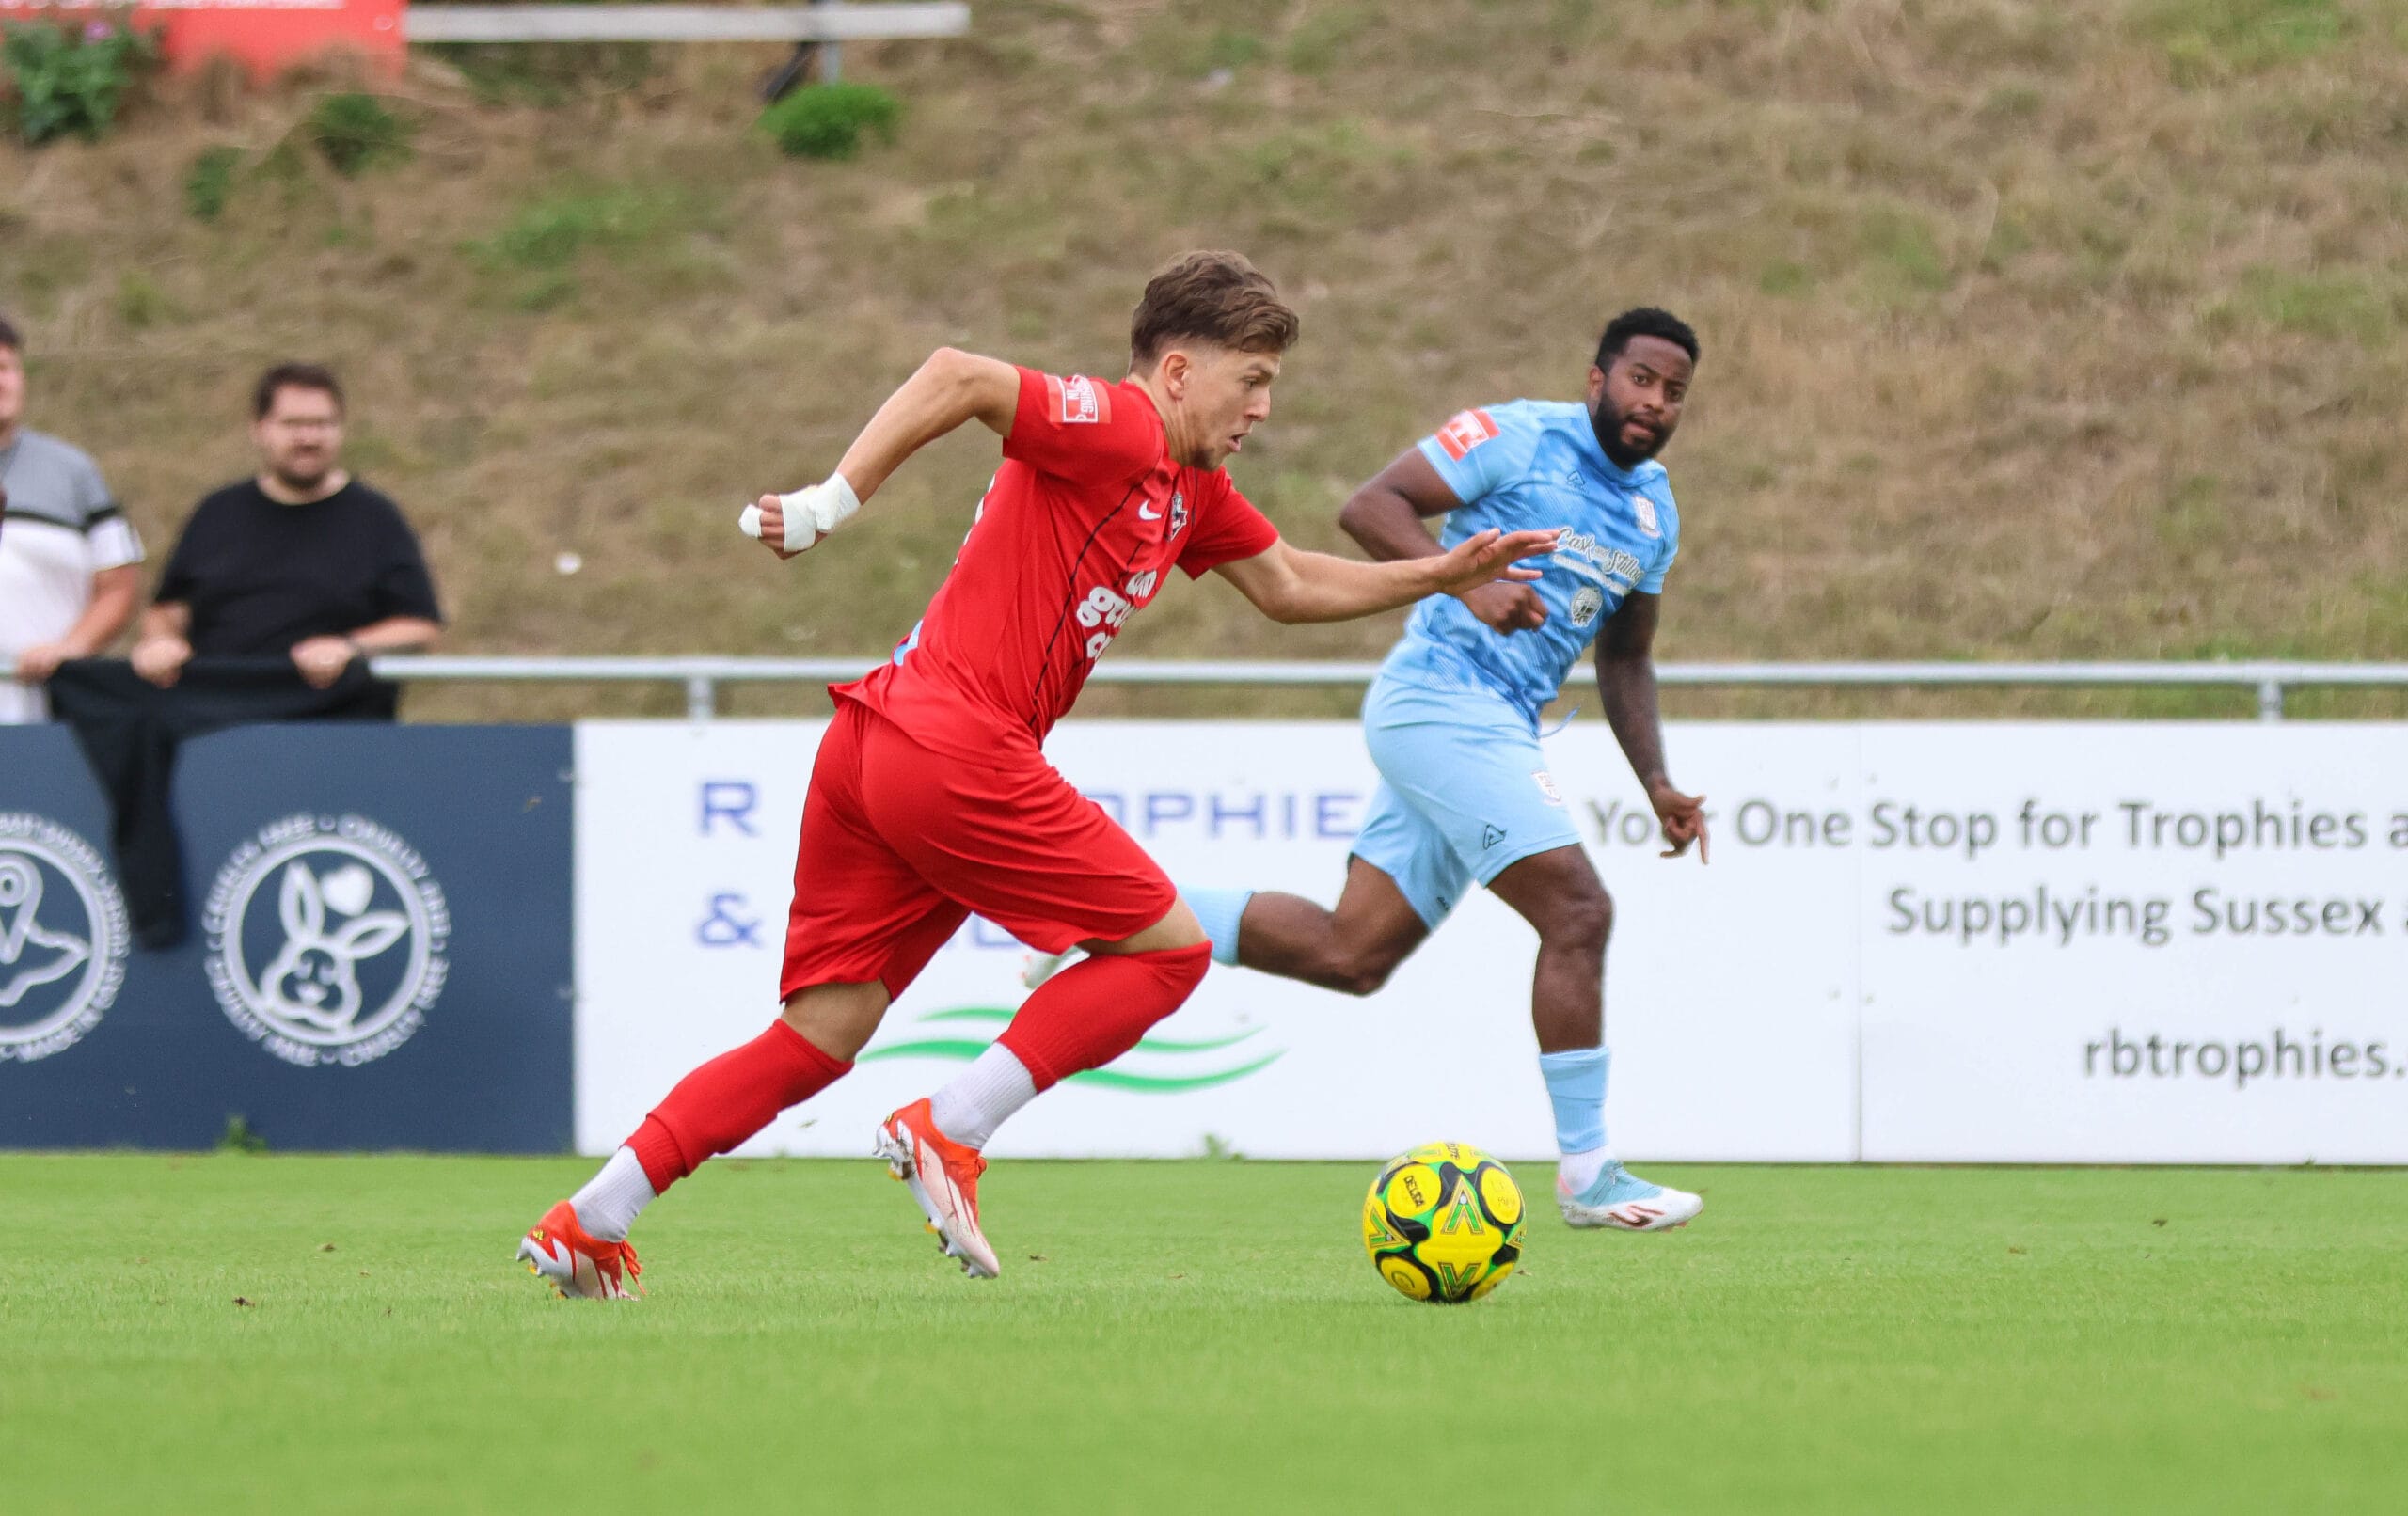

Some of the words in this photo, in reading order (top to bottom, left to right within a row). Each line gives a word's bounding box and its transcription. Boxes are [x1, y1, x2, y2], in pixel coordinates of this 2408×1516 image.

[1555, 525, 1595, 562] Cask
[698, 781, 758, 836] R
[1735, 799, 1851, 847] One
[1871, 802, 1997, 860] Stop
[2018, 798, 2099, 847] for
[2118, 798, 2368, 860] Trophies
[696, 891, 760, 948] &
[1889, 885, 2171, 947] Supplying
[2193, 887, 2384, 936] Sussex
[2084, 1028, 2406, 1089] rbtrophies.
